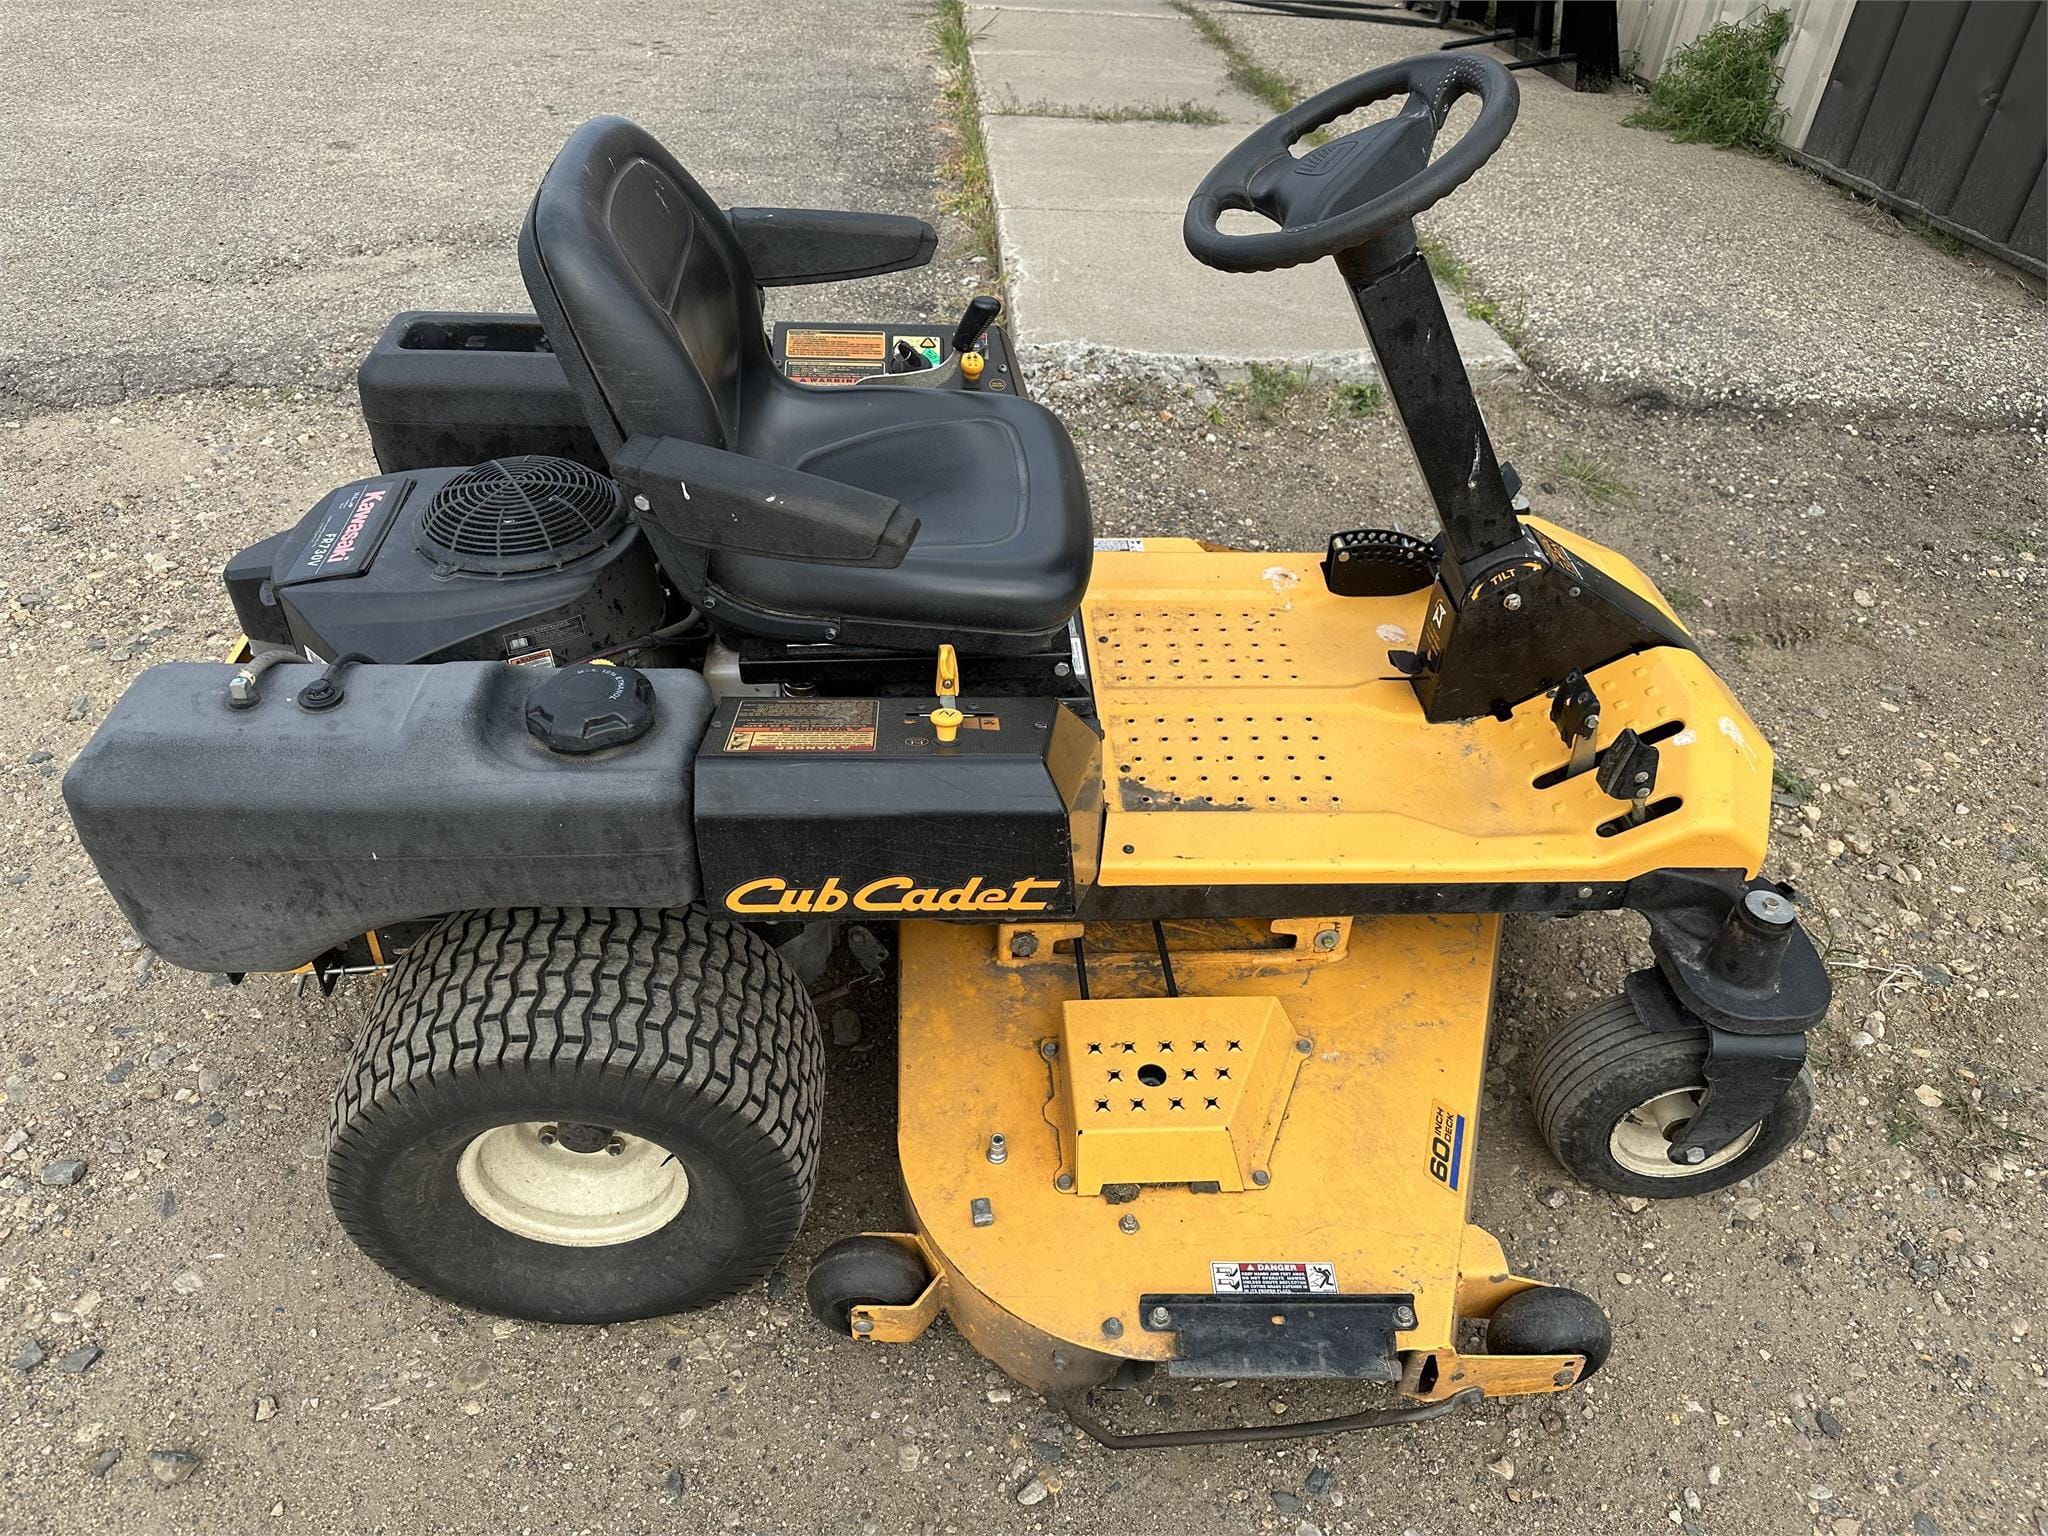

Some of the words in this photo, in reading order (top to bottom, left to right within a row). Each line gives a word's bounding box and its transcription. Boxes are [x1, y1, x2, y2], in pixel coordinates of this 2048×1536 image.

[327, 489, 386, 563] Kawasaki
[307, 532, 334, 567] FR730V
[1490, 568, 1516, 584] TILT
[608, 676, 625, 700] ETHANOL
[725, 876, 848, 913] Cub
[852, 876, 1062, 912] Cadet
[1434, 1106, 1444, 1136] INCH
[1444, 1112, 1454, 1143] DECK
[1429, 1136, 1450, 1182] 60
